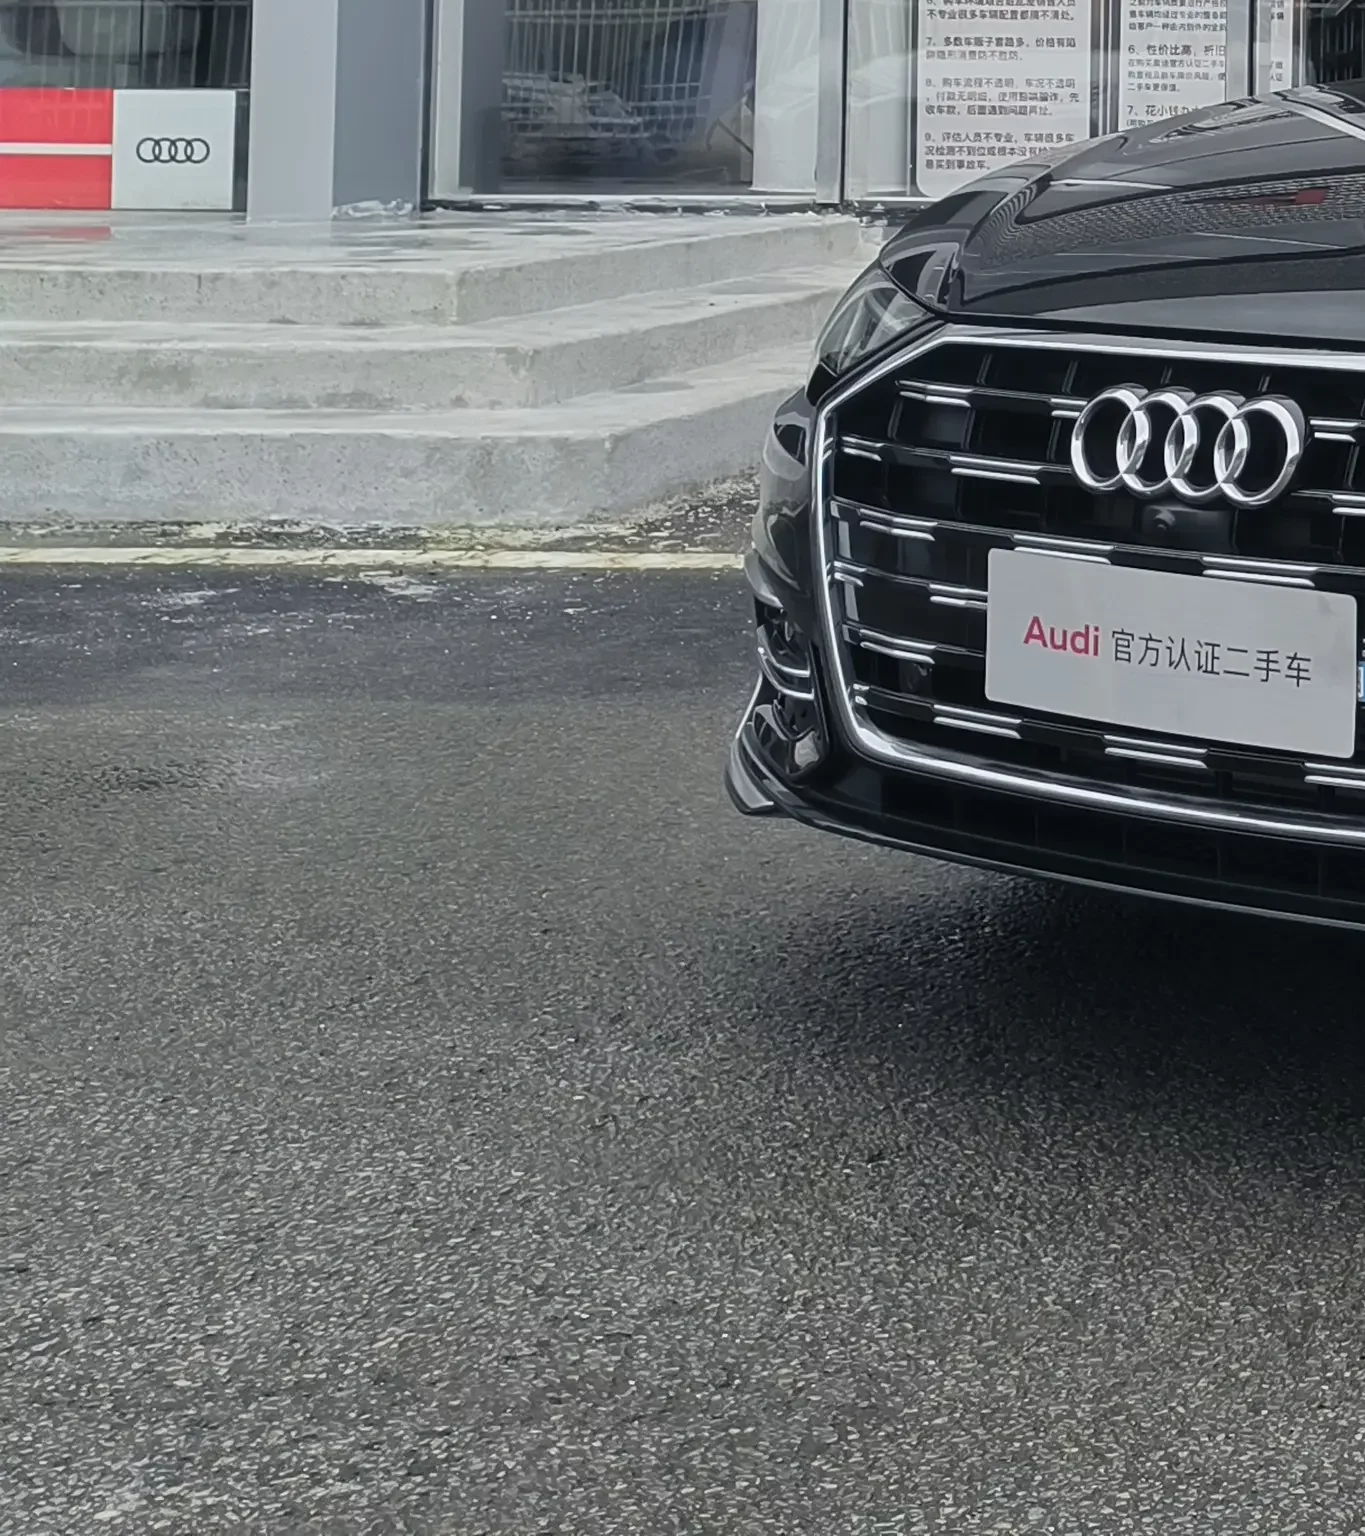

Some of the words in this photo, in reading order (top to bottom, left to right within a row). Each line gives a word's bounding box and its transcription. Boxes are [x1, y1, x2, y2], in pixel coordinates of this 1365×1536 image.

[1023, 616, 1100, 657] Audi
[1111, 628, 1313, 688] 官方认证二手车
